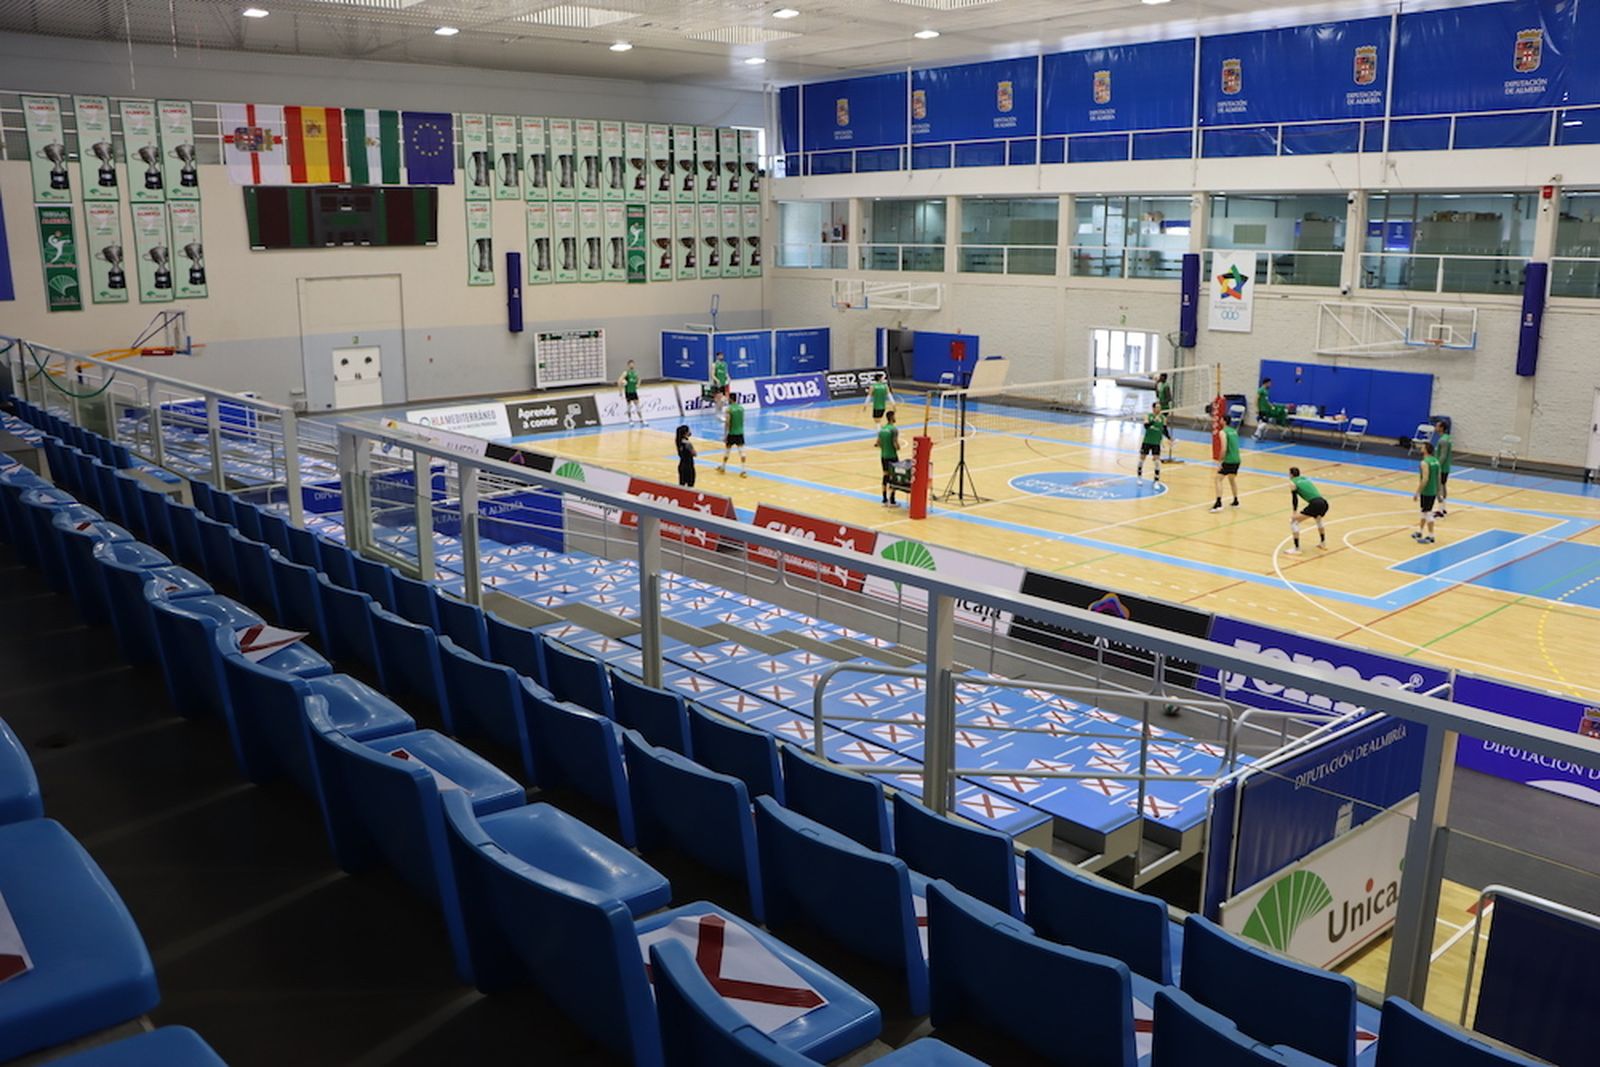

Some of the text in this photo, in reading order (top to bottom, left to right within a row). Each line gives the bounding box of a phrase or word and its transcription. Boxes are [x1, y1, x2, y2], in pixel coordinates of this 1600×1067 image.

[518, 405, 557, 420] Aprende
[530, 417, 559, 428] comer
[1328, 878, 1399, 943] Unica
